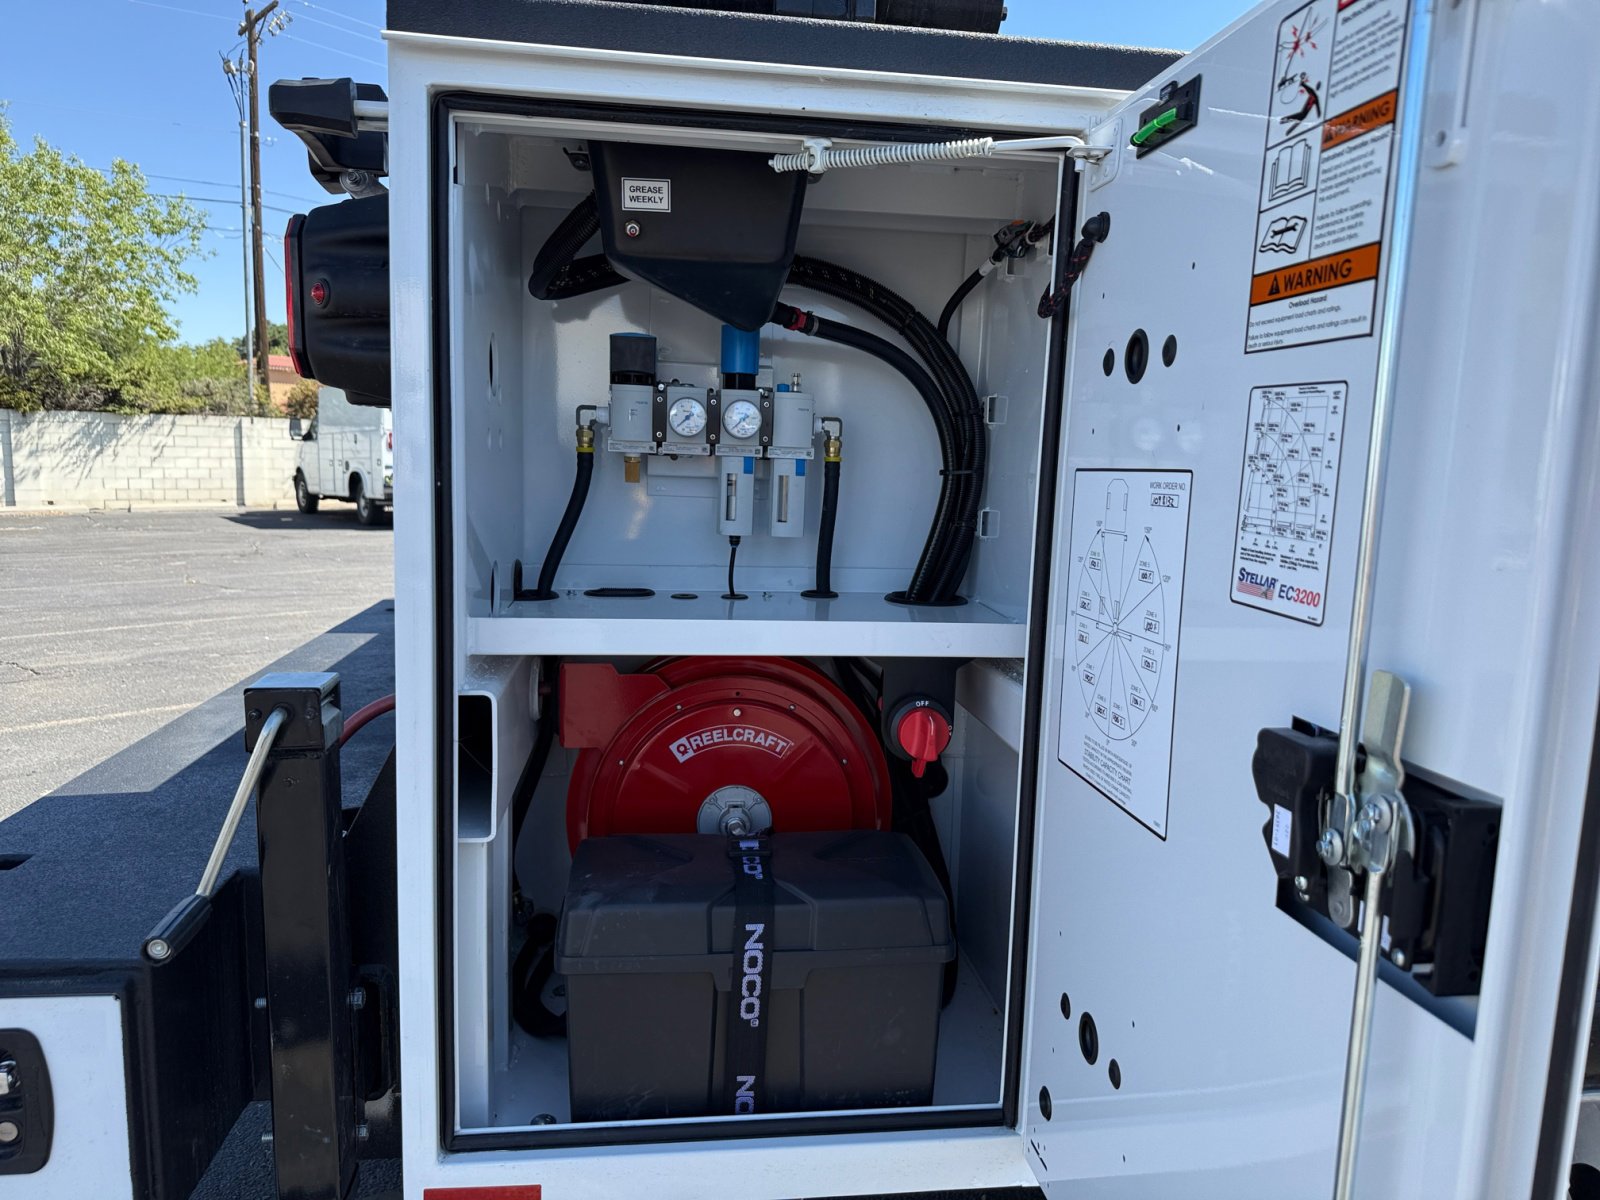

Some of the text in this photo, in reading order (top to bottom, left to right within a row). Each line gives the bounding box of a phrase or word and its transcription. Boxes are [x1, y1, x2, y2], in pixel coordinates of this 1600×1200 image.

[629, 186, 664, 194] GREASE
[629, 195, 664, 204] WEEKLY
[1284, 259, 1352, 292] WARNING
[1238, 567, 1321, 608] STELLAR EC3200
[690, 728, 788, 752] REELCRAFT
